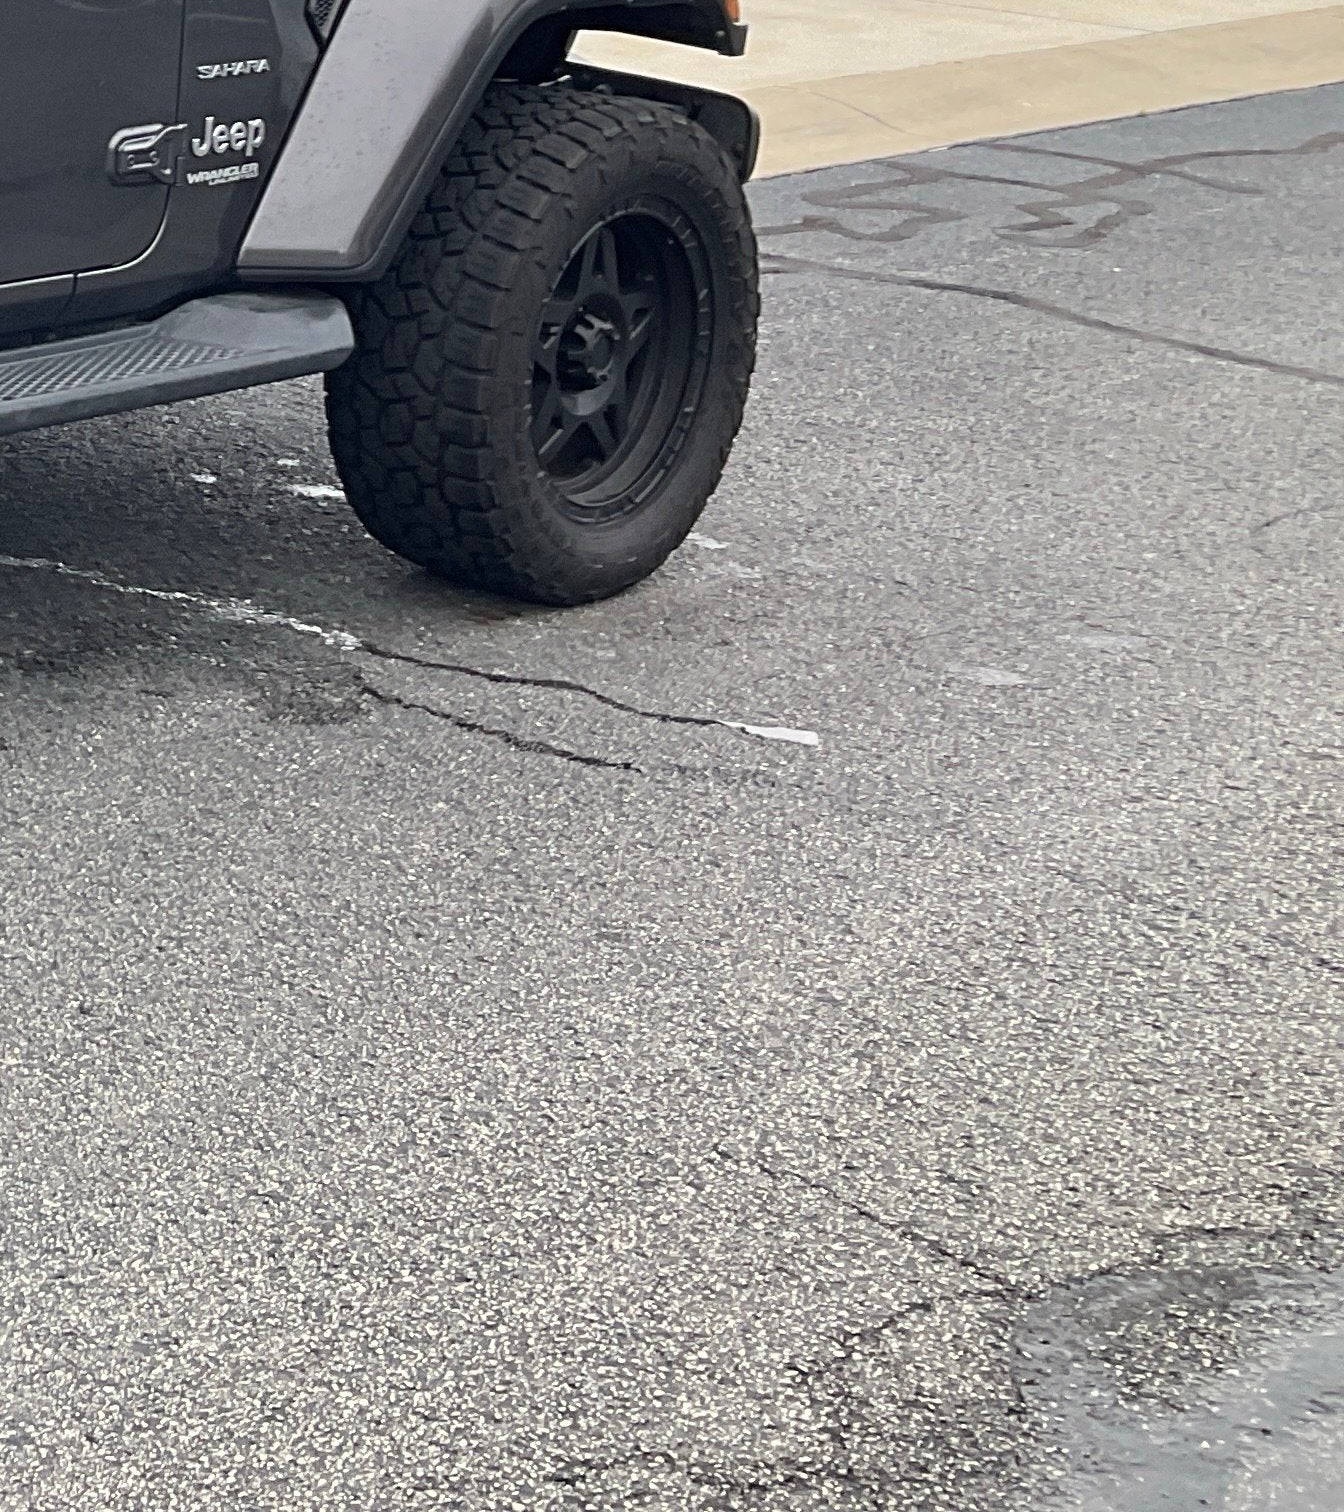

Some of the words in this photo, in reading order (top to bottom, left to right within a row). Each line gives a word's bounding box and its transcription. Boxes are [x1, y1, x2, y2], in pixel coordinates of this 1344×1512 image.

[196, 59, 270, 79] SAHARA
[191, 116, 265, 156] Jeep
[187, 162, 259, 184] WRANGLER
